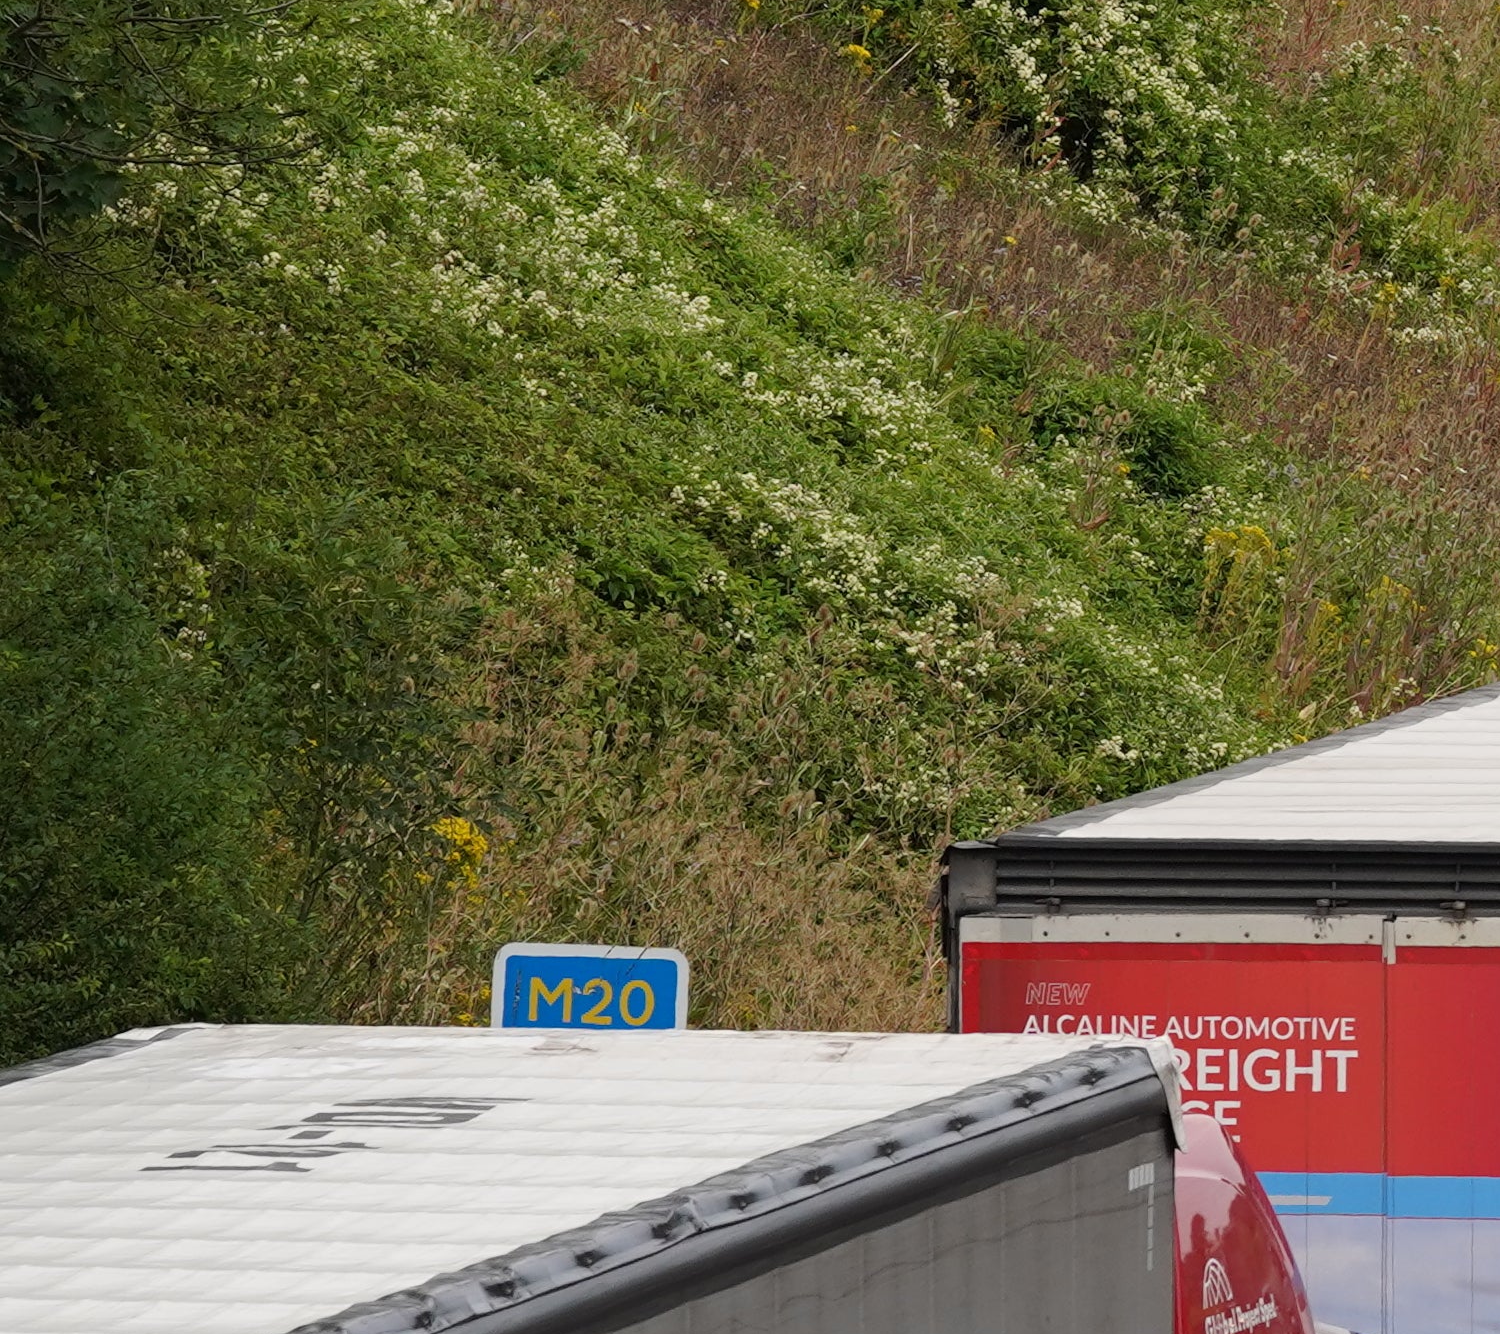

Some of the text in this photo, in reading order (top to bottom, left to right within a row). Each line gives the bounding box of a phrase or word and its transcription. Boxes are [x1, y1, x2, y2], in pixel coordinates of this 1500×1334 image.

[528, 976, 656, 1027] M20
[1024, 982, 1092, 1006] NEW
[1163, 1015, 1357, 1041] AUTOMOTIVE
